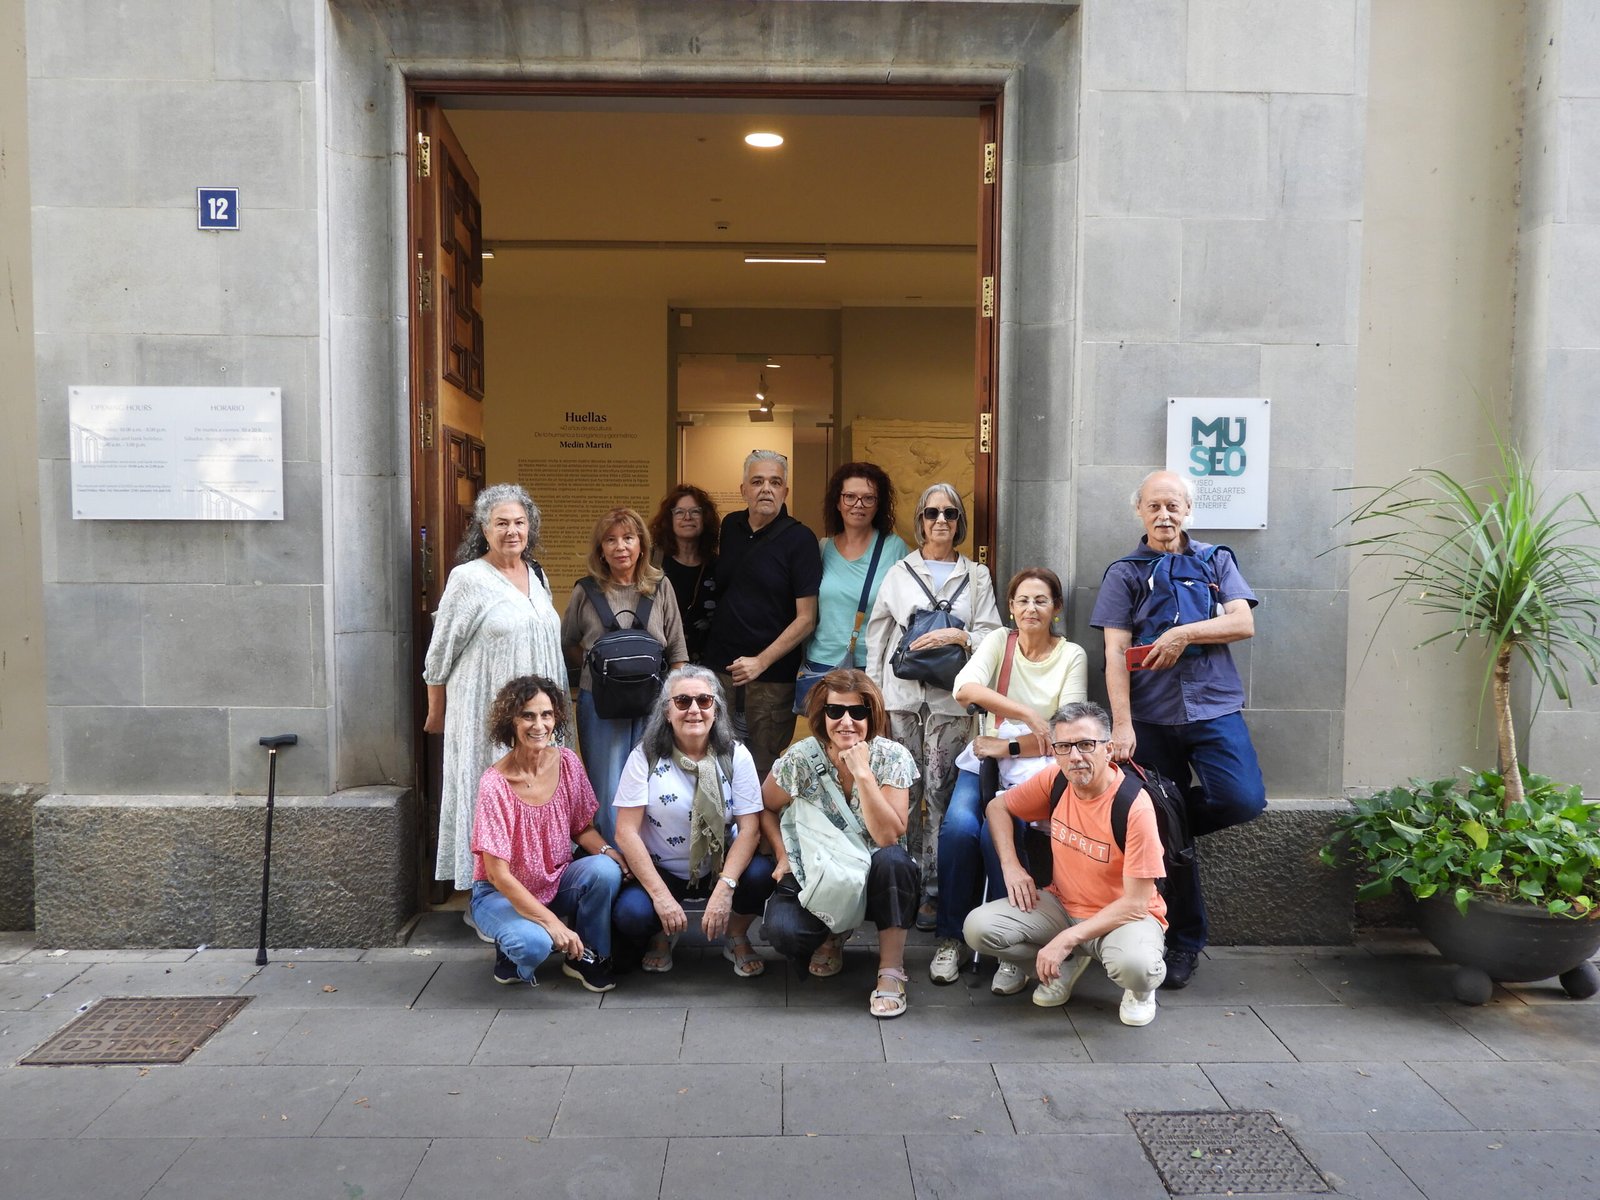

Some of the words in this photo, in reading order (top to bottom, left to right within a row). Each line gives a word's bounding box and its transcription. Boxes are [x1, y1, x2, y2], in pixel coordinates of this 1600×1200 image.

[207, 197, 229, 220] 12
[565, 411, 607, 423] Huellas
[1193, 479, 1214, 487] USEO
[1222, 486, 1246, 494] ARTES
[1194, 502, 1228, 510] TENERIFE
[1051, 822, 1106, 858] ESPRIT
